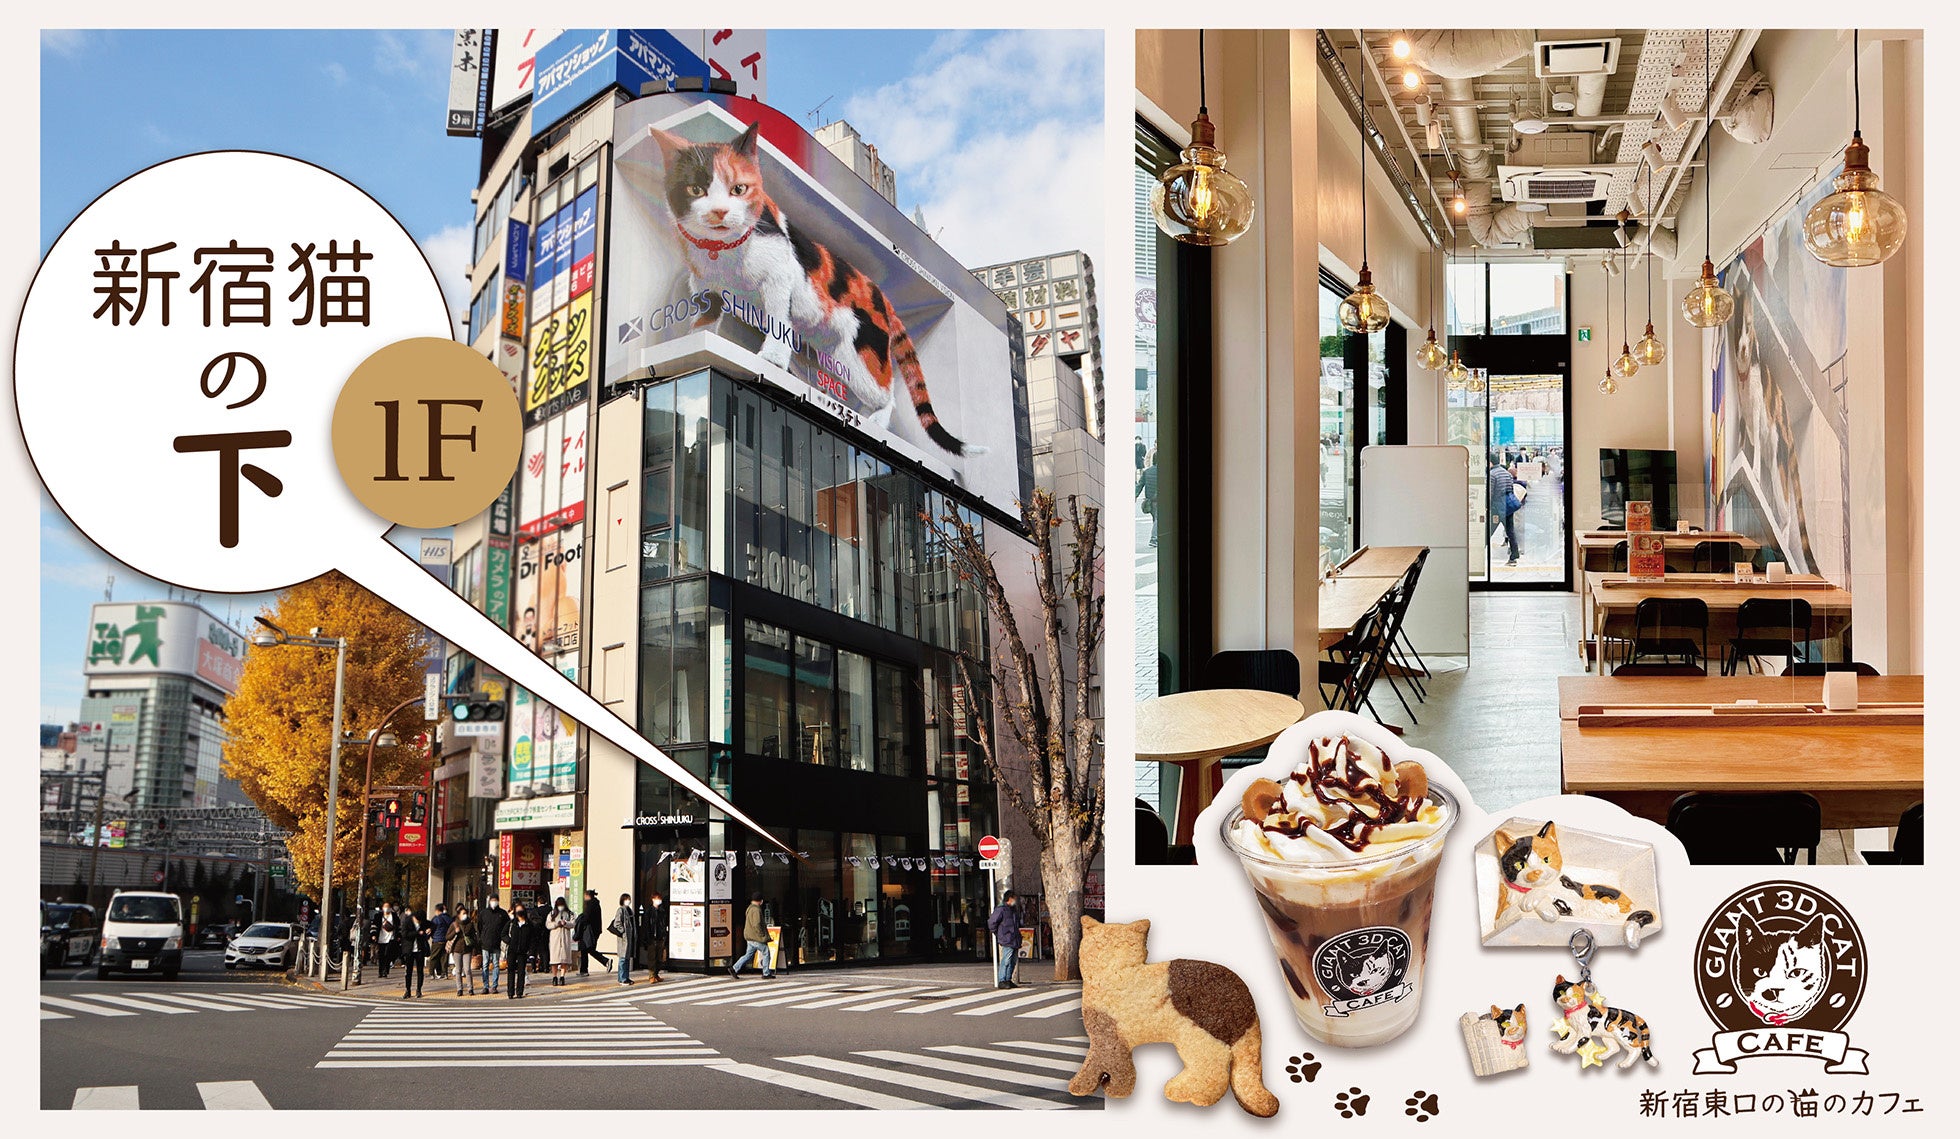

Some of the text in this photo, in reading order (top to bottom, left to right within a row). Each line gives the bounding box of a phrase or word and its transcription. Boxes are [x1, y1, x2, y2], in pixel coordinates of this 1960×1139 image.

[538, 29, 610, 96] アパマンショップ
[532, 308, 587, 368] ダーツ
[650, 288, 802, 353] CROSS SHINJUKU
[531, 339, 588, 404] グッズ
[816, 350, 851, 381] VISION
[817, 370, 849, 401] SPACE
[423, 546, 447, 558] HIS
[520, 543, 583, 580] Dr Foot
[635, 814, 693, 825] CROSS SHINJUKU
[1321, 933, 1407, 979] GIANT 3D CAT
[1346, 990, 1395, 1010] CAFE
